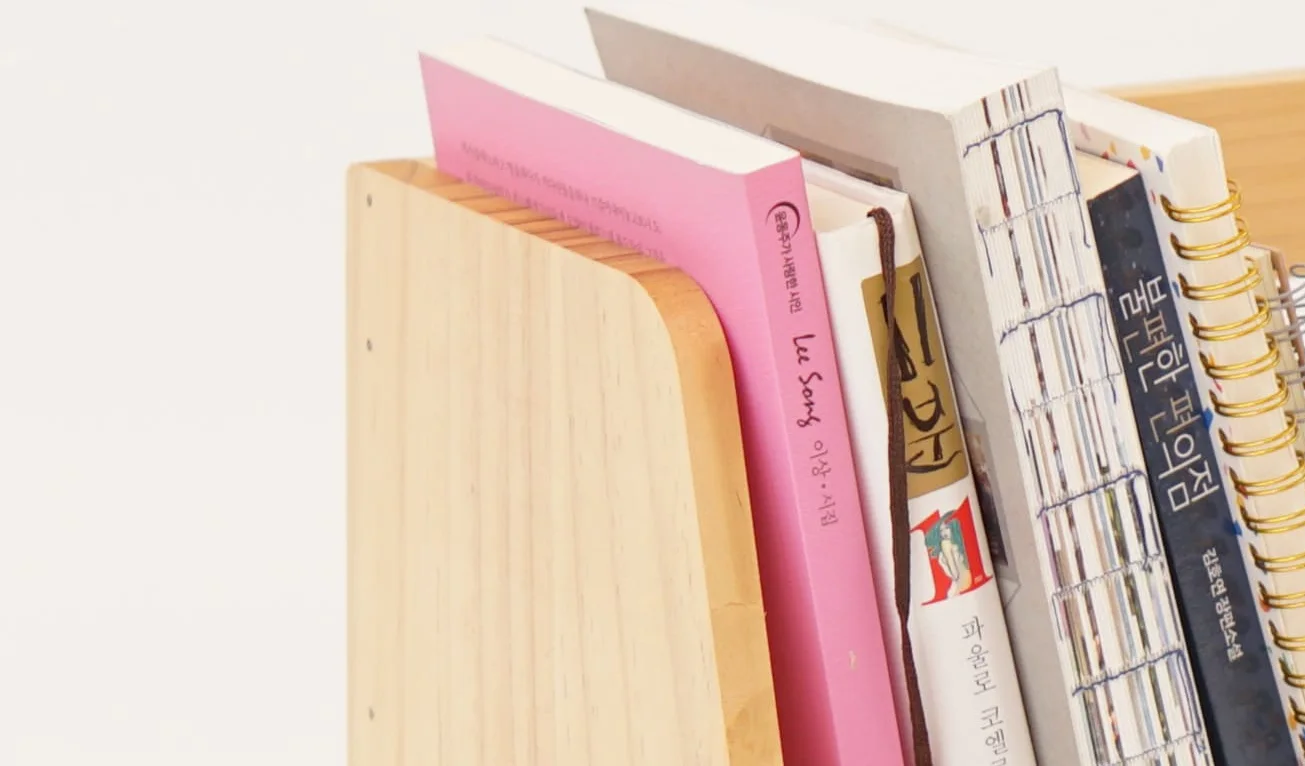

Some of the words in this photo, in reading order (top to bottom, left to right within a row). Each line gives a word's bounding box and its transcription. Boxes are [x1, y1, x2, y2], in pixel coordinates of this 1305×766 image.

[774, 211, 793, 256] 윤동주가
[783, 256, 798, 290] 사랑한
[788, 291, 803, 315] 시인
[792, 333, 817, 366] Lee
[1118, 275, 1190, 393] 불편한
[809, 439, 833, 480] 이상
[1150, 389, 1220, 513] 편의점
[817, 493, 840, 527] 시집
[1202, 547, 1228, 599] 김호연
[1215, 596, 1244, 663] 장편소설
[960, 615, 997, 696] 파울로
